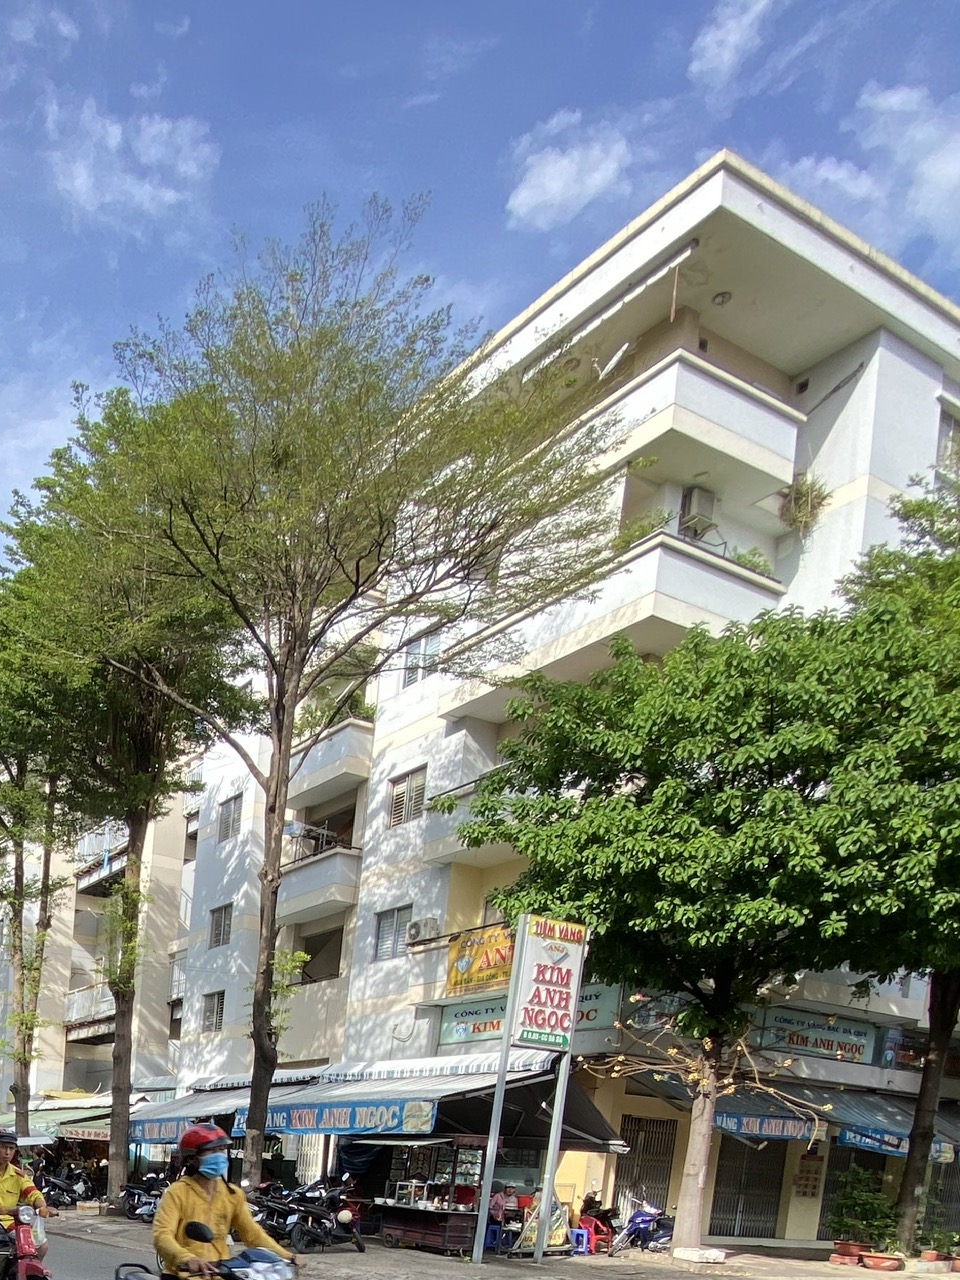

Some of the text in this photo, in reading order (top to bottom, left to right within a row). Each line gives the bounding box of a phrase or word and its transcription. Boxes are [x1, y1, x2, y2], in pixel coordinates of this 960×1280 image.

[558, 923, 583, 945] VÀNG
[533, 963, 573, 987] KIM
[528, 986, 572, 1011] ANH
[454, 1007, 482, 1019] CÔNG
[485, 1005, 497, 1015] TY
[520, 1006, 571, 1032] NGỌC
[774, 1015, 795, 1026] CÔNG
[471, 1019, 501, 1034] KIM
[788, 1032, 810, 1047] KIM
[812, 1037, 835, 1051] ANH
[265, 1109, 287, 1127] ÀNG
[290, 1109, 318, 1129] KIM
[319, 1107, 350, 1128] ANH
[355, 1105, 400, 1131] NGỌC
